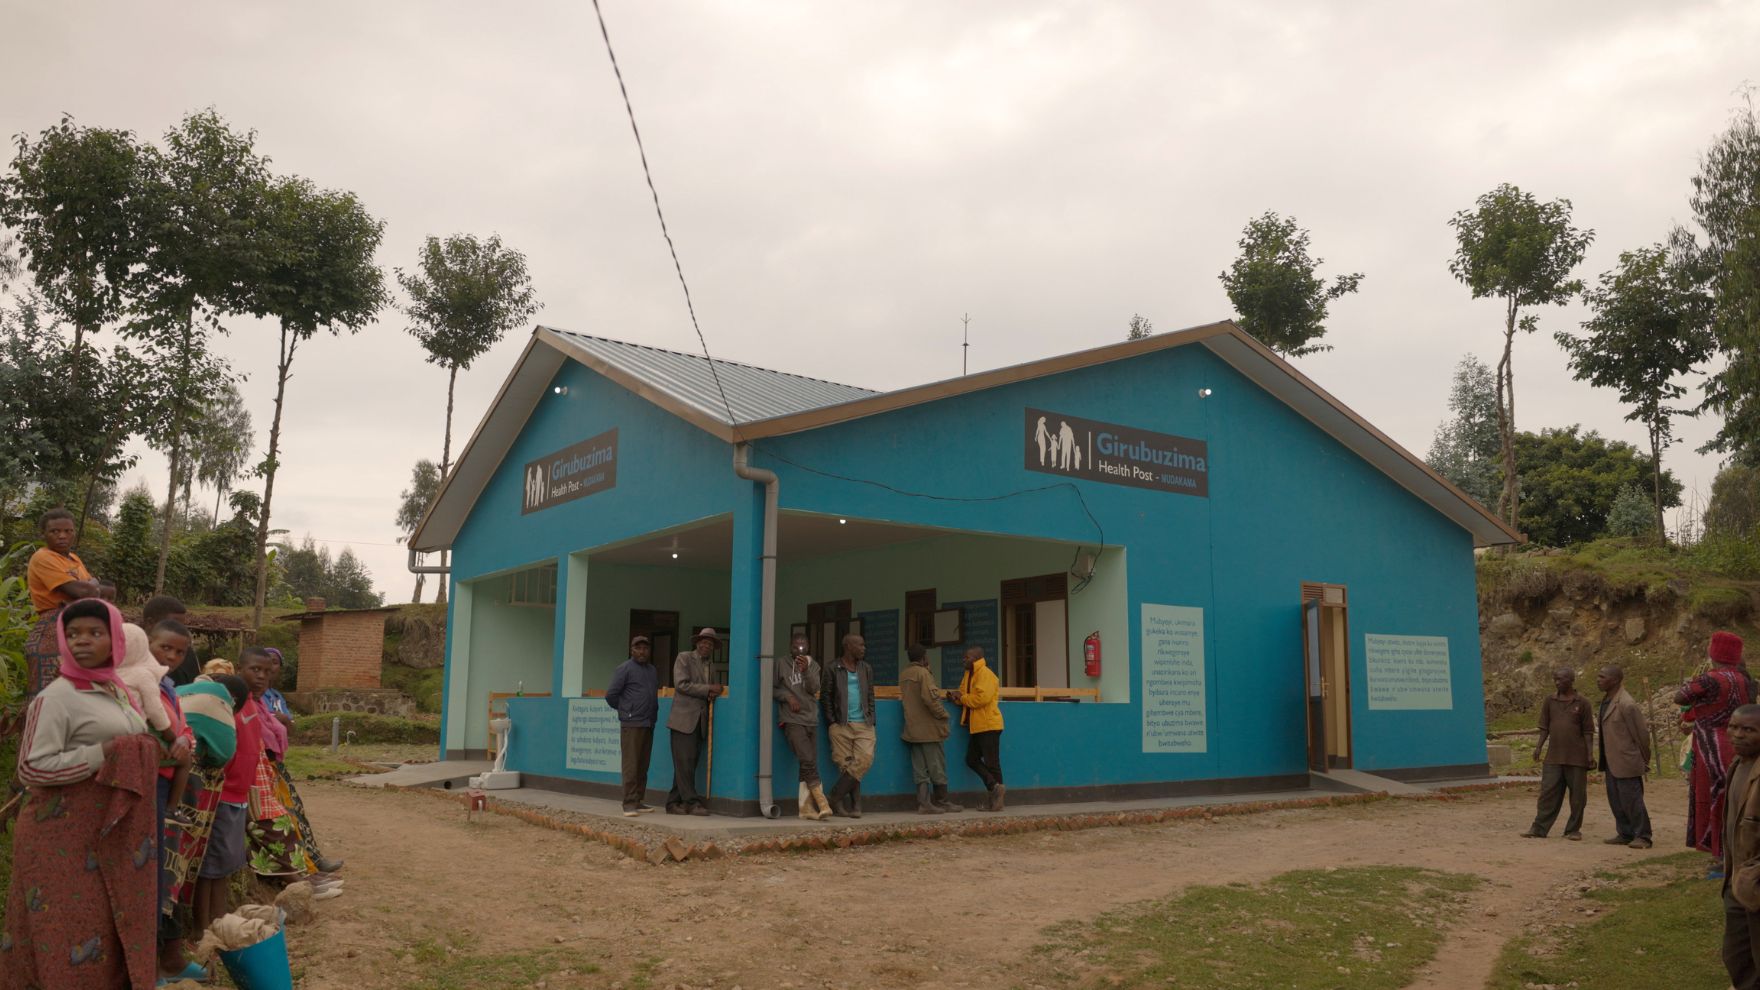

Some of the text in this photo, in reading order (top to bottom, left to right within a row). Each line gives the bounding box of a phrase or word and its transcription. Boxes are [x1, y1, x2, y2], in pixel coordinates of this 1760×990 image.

[552, 447, 612, 480] Girubuzima
[1096, 432, 1206, 472] Girubuzima
[1098, 459, 1131, 478] Health
[1133, 465, 1153, 481] Post
[551, 484, 568, 498] Health
